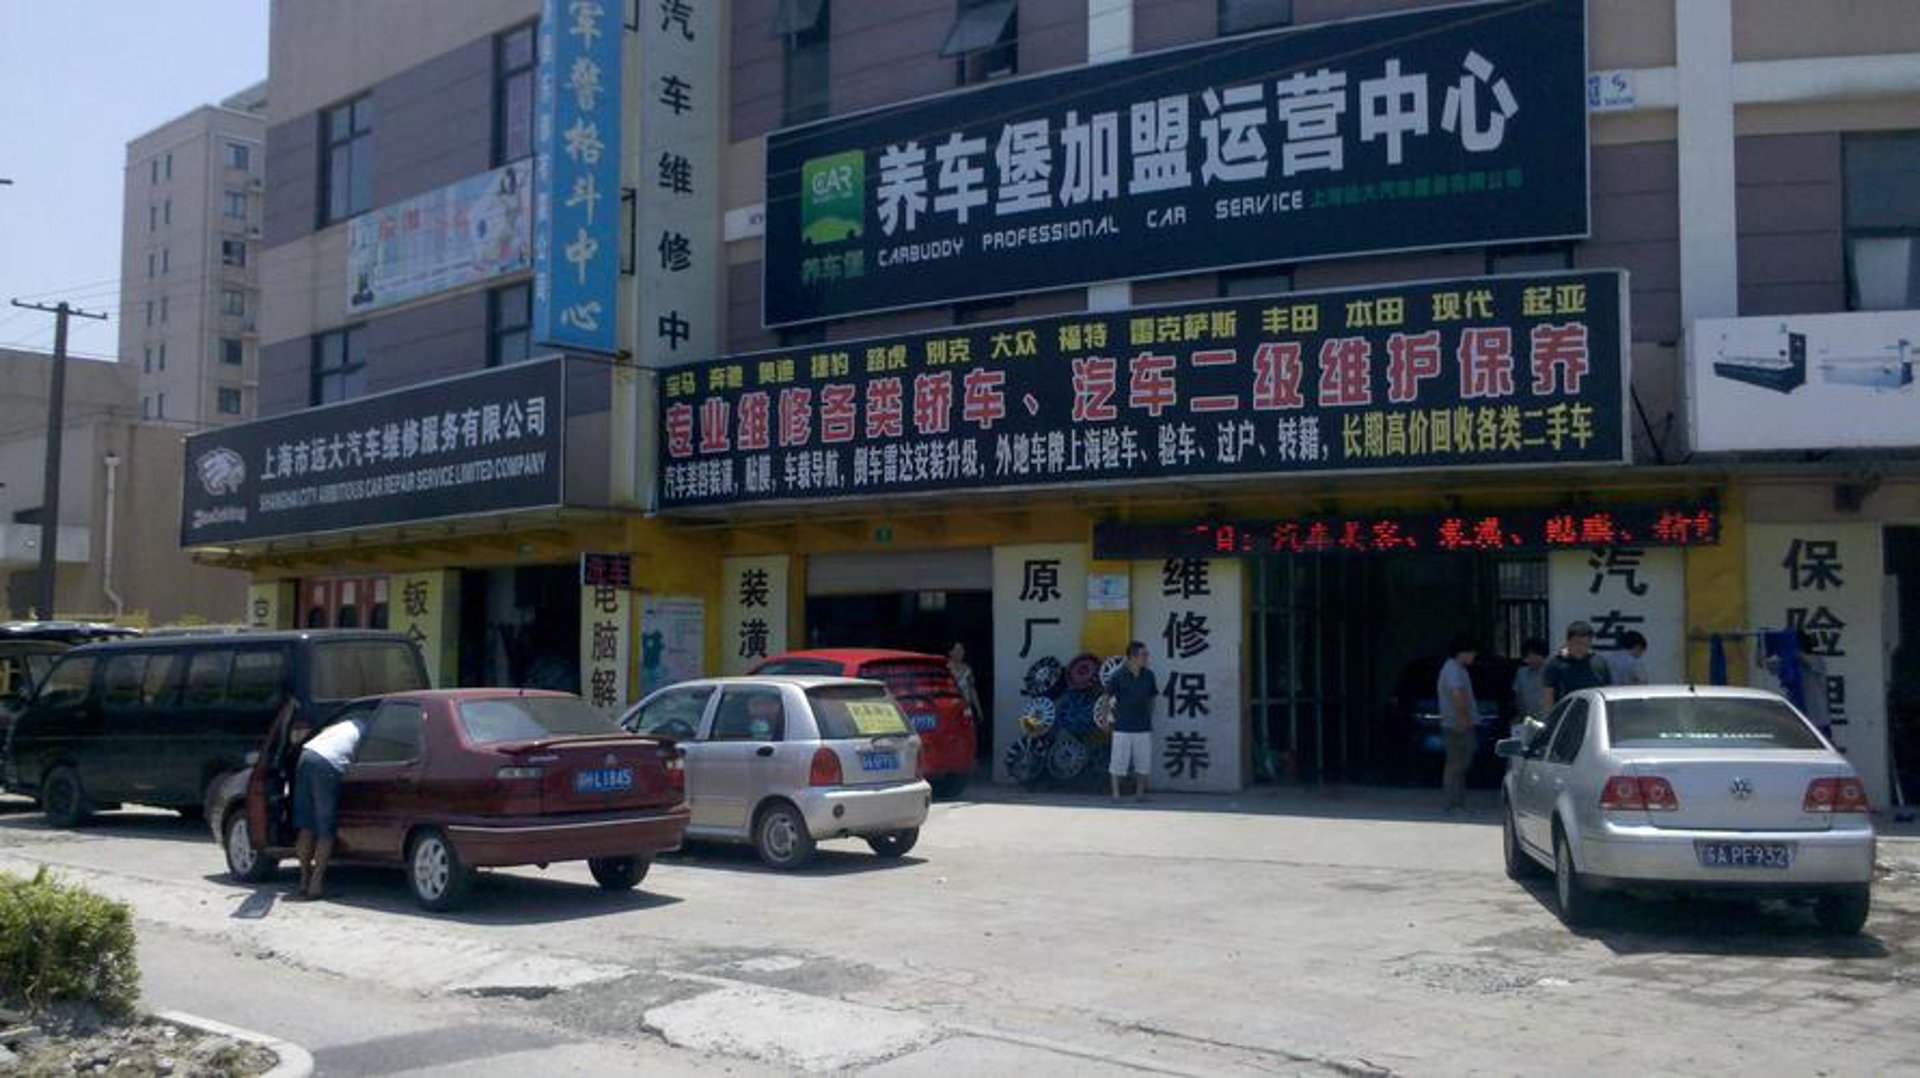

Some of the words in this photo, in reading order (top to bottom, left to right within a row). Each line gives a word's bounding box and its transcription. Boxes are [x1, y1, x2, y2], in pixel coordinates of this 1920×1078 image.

[559, 0, 605, 332] 军警格斗中心
[877, 50, 1519, 237] 养车堡加盟运营中心
[878, 238, 964, 268] CARBUDDY
[983, 216, 1120, 251] PROFESSIONAL
[1147, 206, 1187, 229] CAR
[1215, 190, 1303, 220] SERVICE
[867, 345, 907, 372] 路虎
[926, 338, 971, 366] 别克
[990, 330, 1037, 359] 大众
[1058, 323, 1107, 352] 福特
[1130, 309, 1237, 346] 雷克萨斯
[1262, 304, 1319, 335] 丰田
[1346, 296, 1404, 328] 本田
[1432, 289, 1494, 322] 现代
[1522, 283, 1588, 316] 起亚
[260, 396, 547, 481] 上海市远大汽车维修服务有限公司
[416, 465, 454, 490] SERVICE
[495, 451, 547, 479] COMPANY
[740, 569, 770, 660] 装潢
[1019, 559, 1063, 660] 原厂
[1162, 556, 1213, 782] 维修保养
